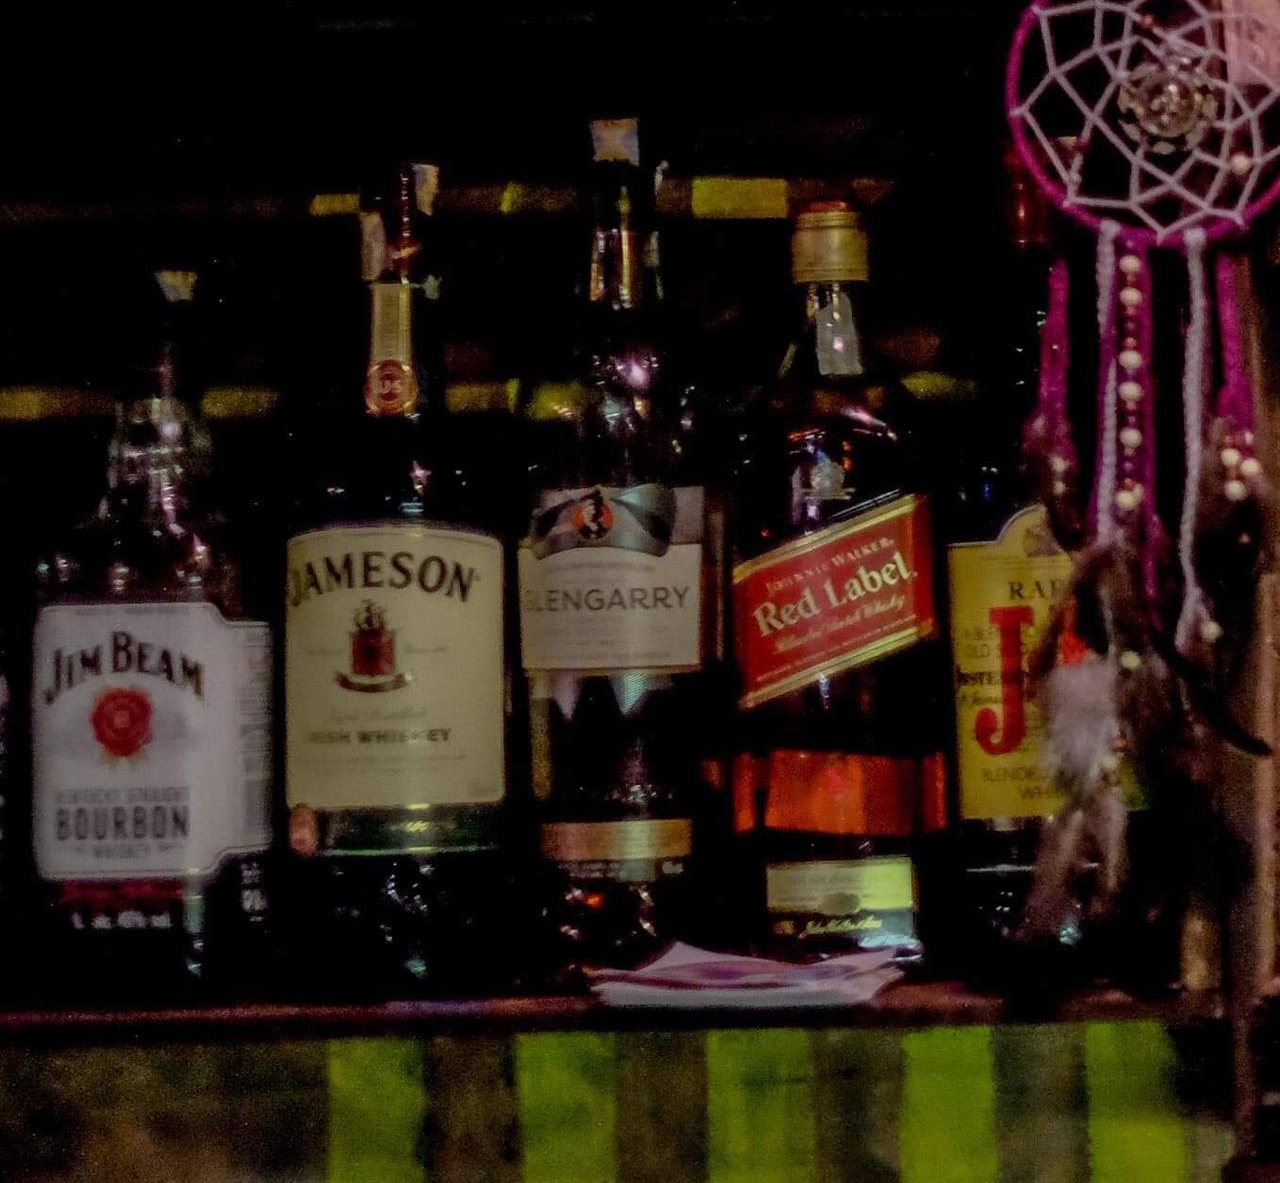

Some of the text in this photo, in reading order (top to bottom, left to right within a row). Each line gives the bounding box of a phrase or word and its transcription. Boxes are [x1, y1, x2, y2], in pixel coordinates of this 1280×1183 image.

[292, 550, 474, 607] JAMESON
[752, 587, 821, 638] Red
[44, 630, 205, 705] JIM BEAM
[55, 805, 190, 842] BOURBON
